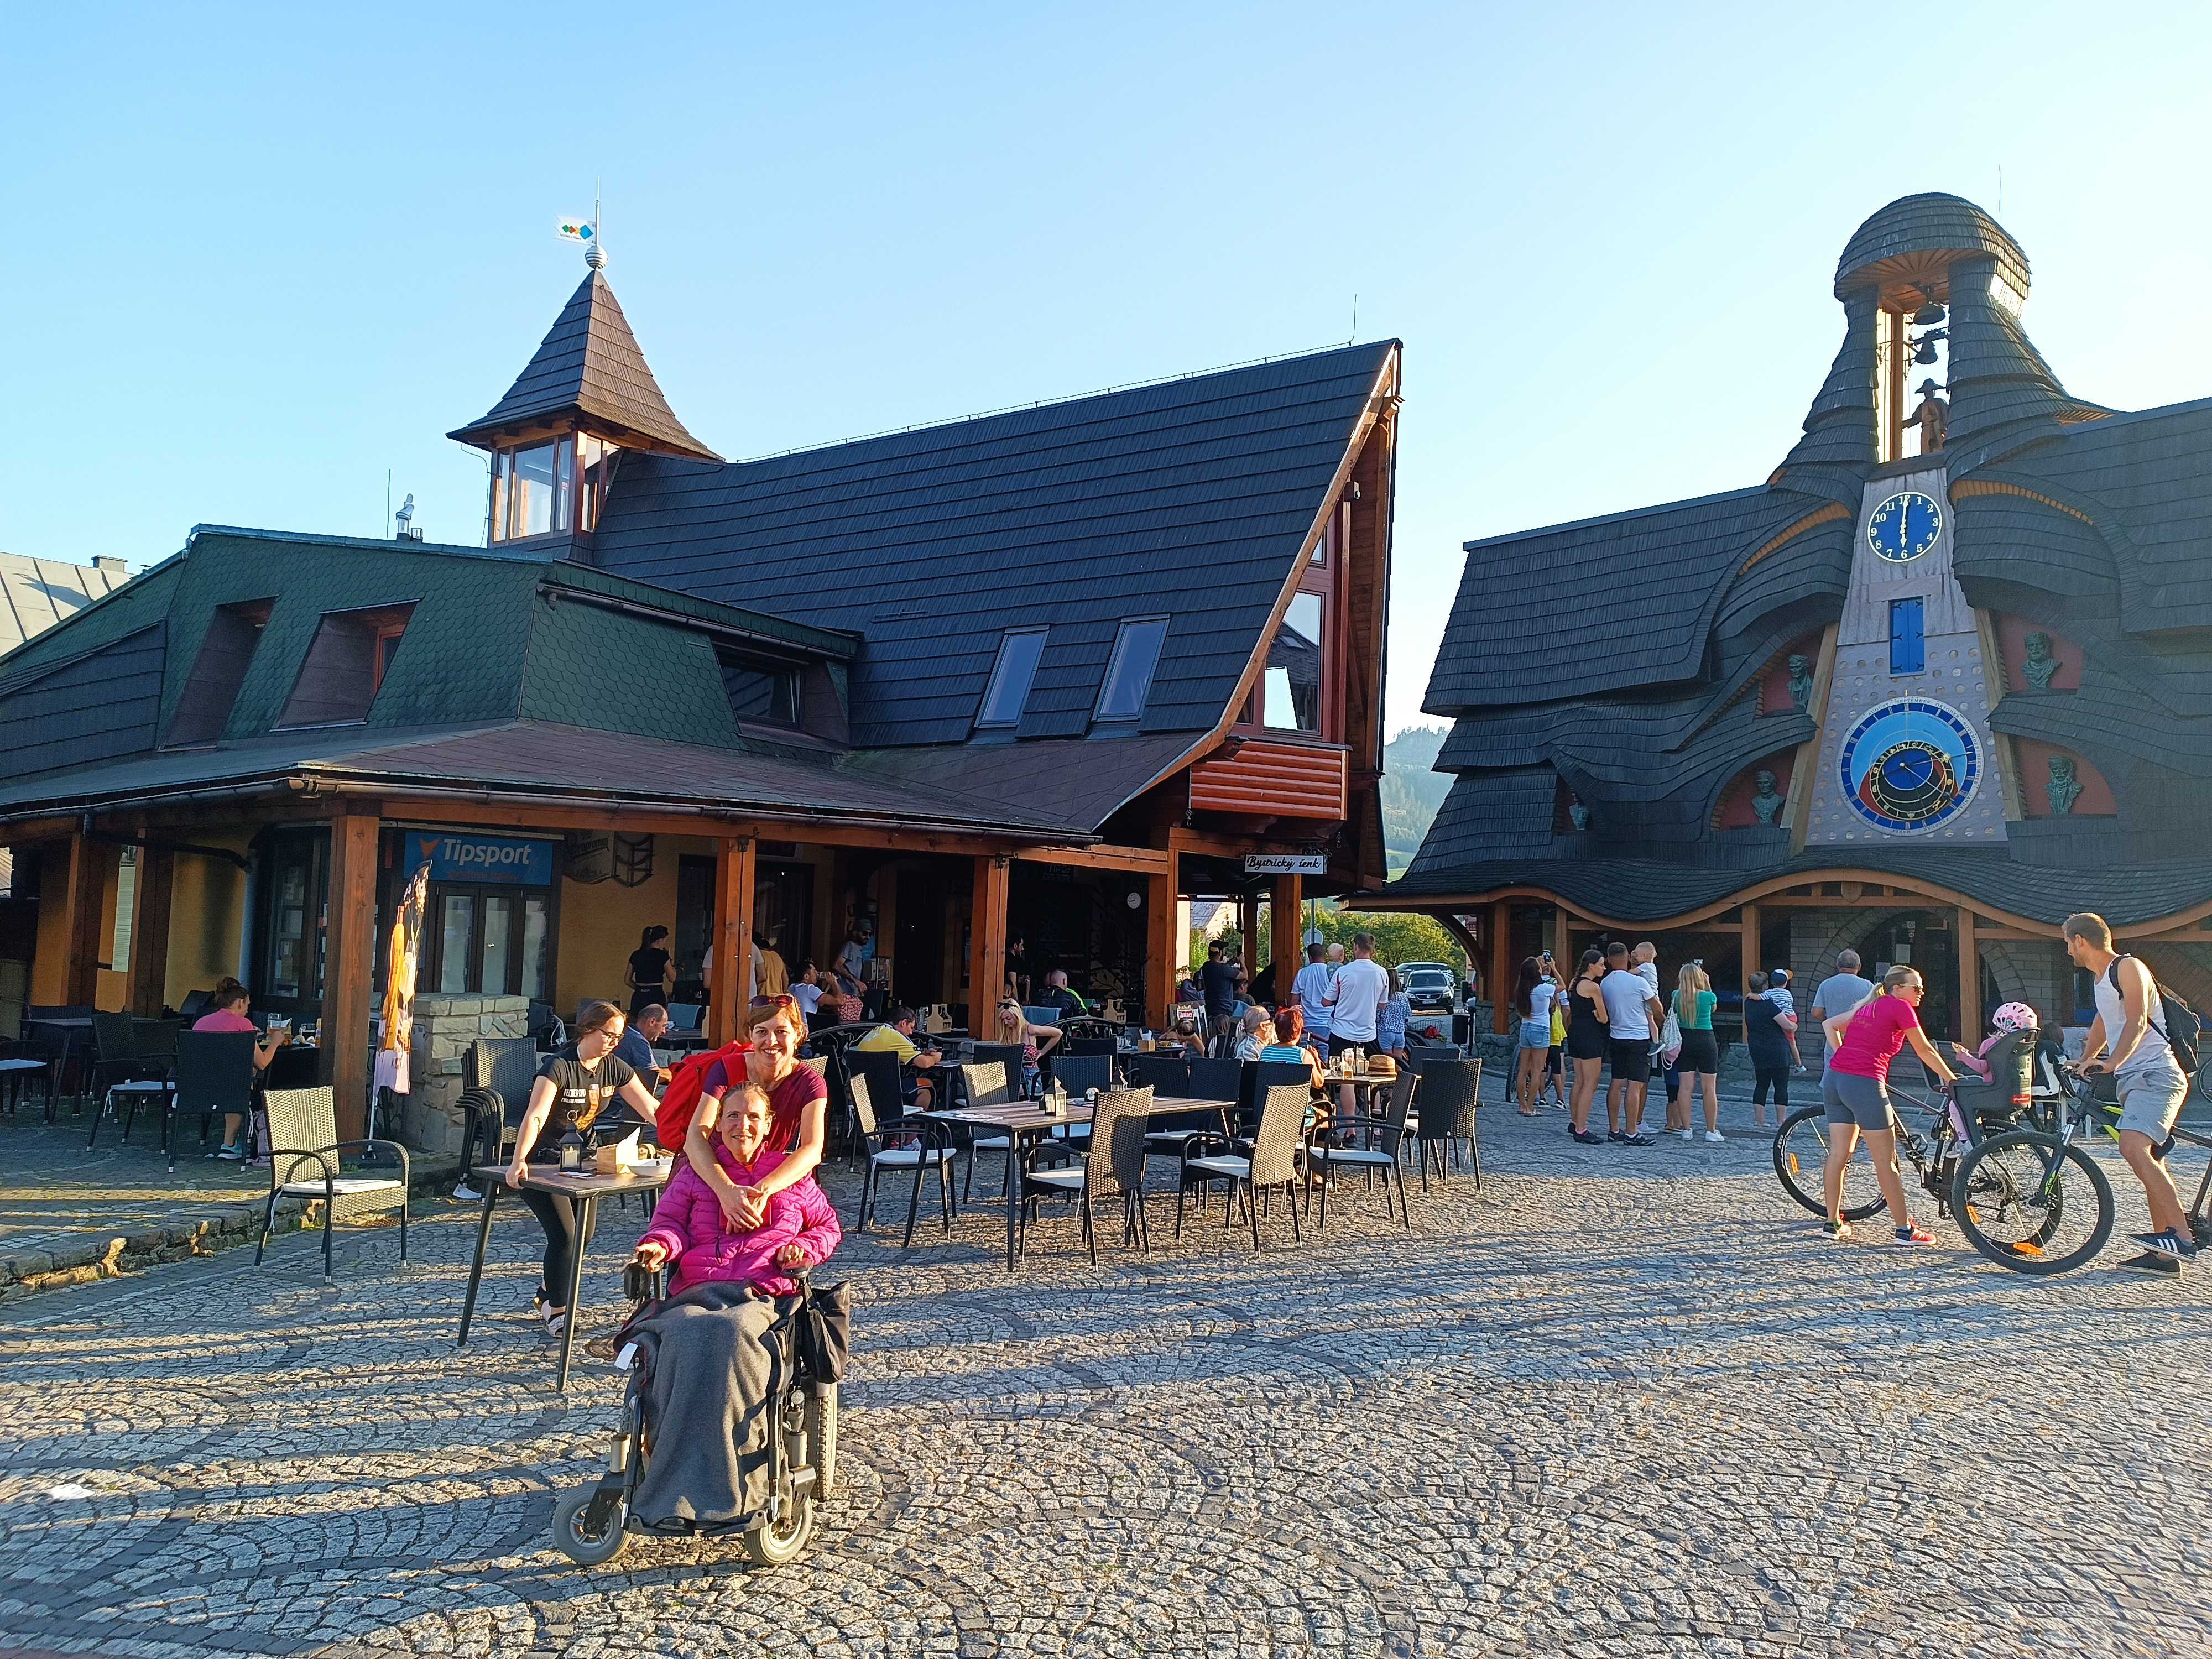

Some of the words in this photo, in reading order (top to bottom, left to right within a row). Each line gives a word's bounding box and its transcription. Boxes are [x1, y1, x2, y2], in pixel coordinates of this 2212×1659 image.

[1916, 497, 1923, 505] 1
[1885, 502, 1896, 512] 11
[1927, 504, 1934, 513] 2
[1875, 513, 1886, 523] 10
[1932, 517, 1939, 526] 3
[1870, 528, 1877, 536] 9
[1927, 532, 1933, 541] 4
[1875, 540, 1882, 549] 8
[1916, 544, 1923, 552] 5
[1886, 549, 1893, 557] 7
[1901, 550, 1908, 559] 6
[1963, 721, 1980, 749] NOVEMBER
[443, 838, 531, 867] Tipsport
[1246, 855, 1295, 871] Bystrický
[1298, 857, 1321, 868] šenk
